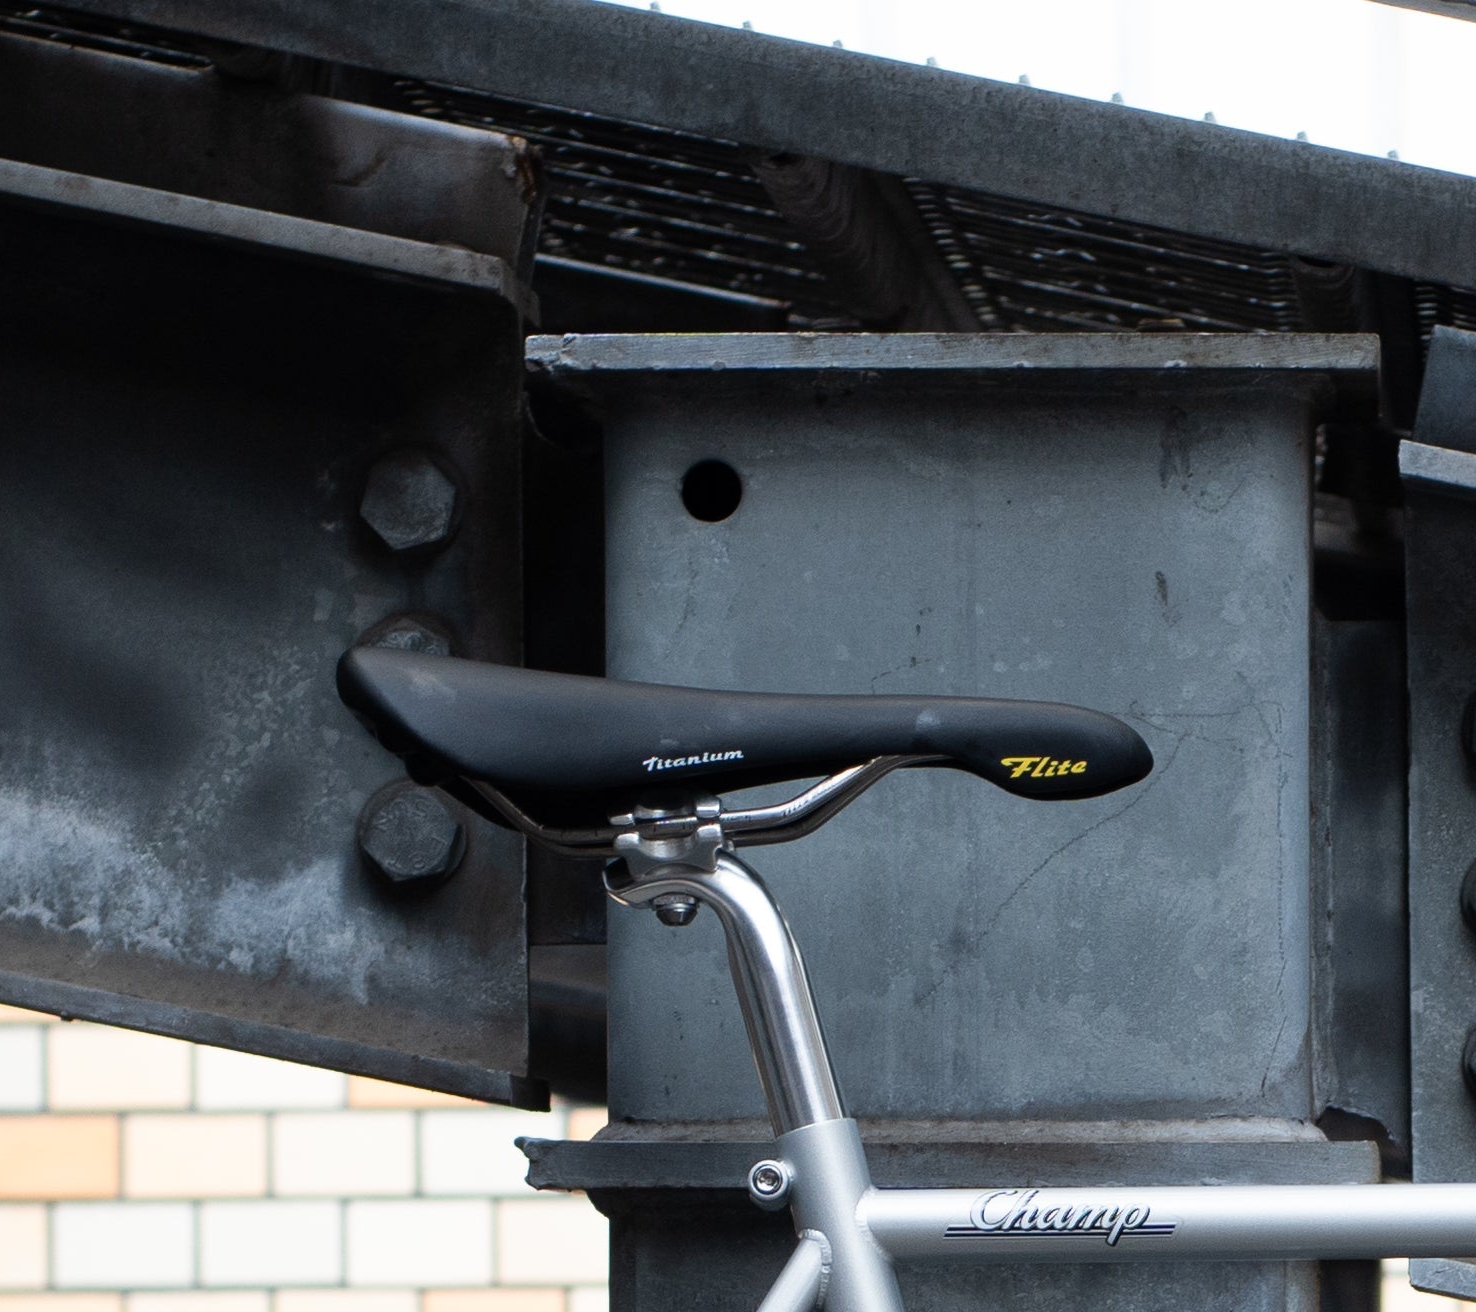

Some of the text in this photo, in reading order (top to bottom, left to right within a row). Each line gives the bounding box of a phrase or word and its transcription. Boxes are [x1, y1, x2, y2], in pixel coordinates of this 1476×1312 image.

[642, 750, 744, 772] Titanium
[1000, 756, 1088, 779] Flite
[970, 1189, 1151, 1247] Champ
